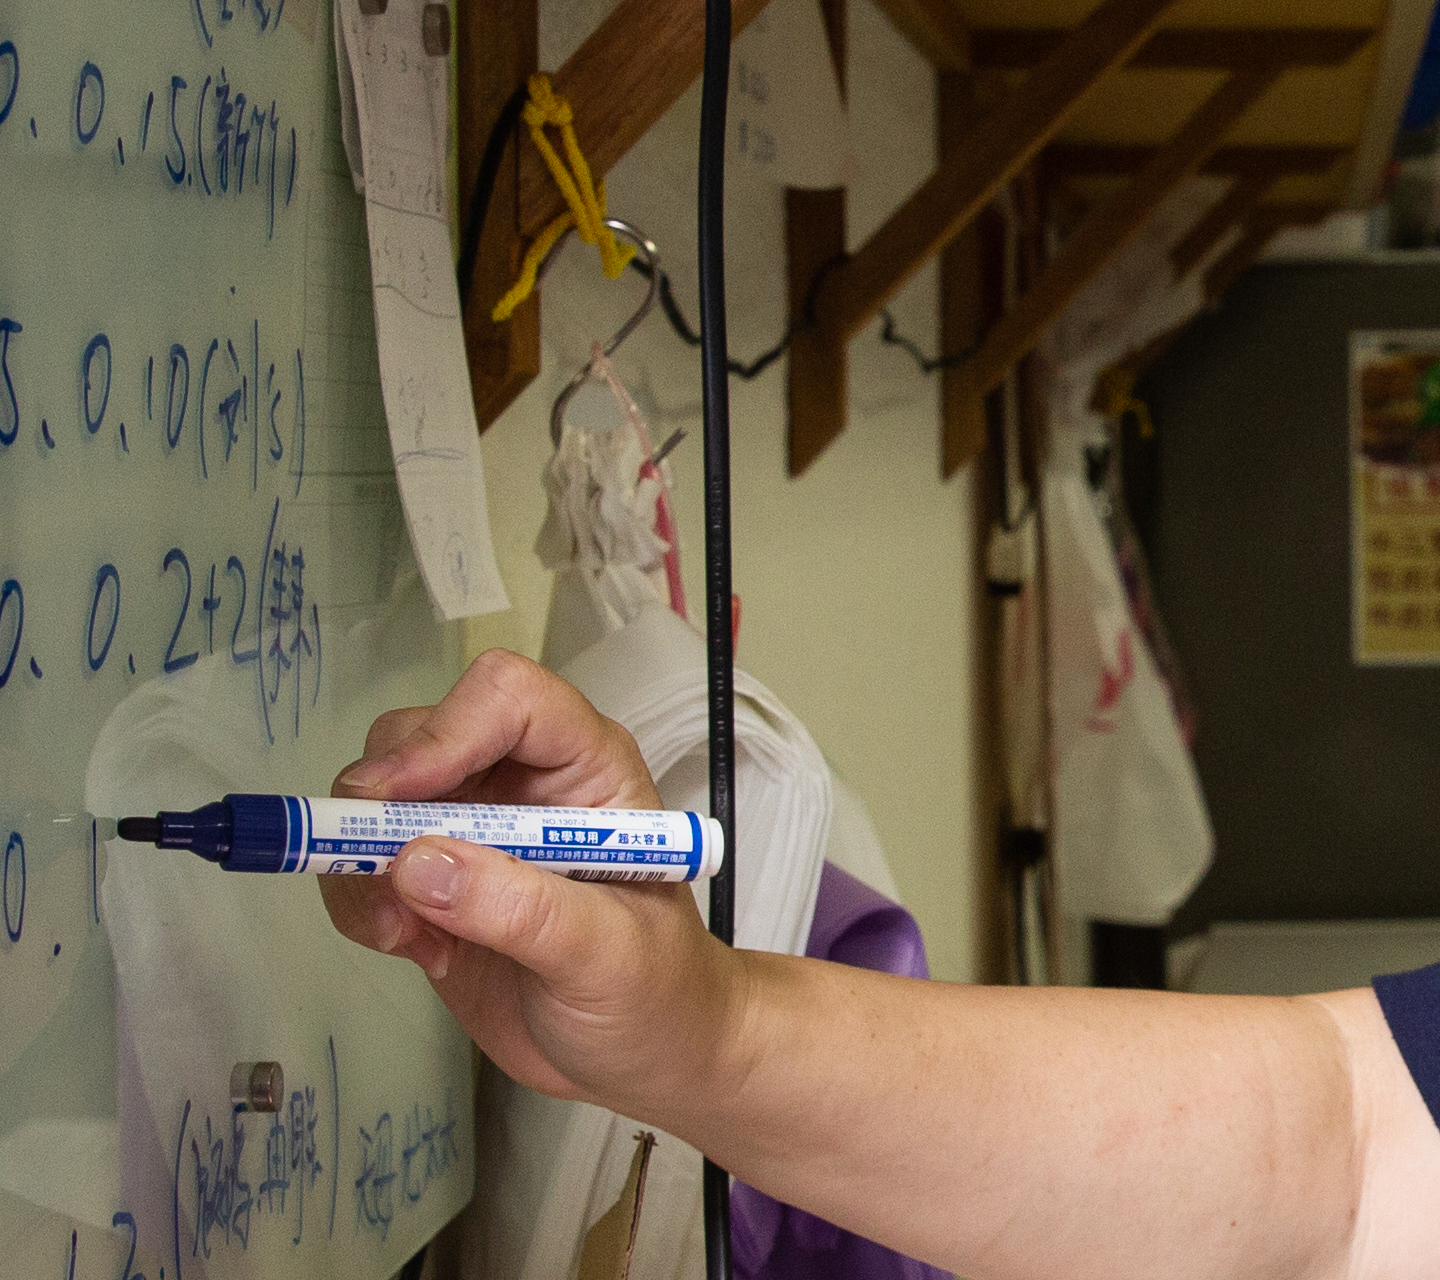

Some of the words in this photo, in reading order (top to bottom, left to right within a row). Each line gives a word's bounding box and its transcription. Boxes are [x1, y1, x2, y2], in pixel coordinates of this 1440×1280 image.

[548, 830, 599, 844] 教學專用
[618, 832, 668, 846] 超大容量
